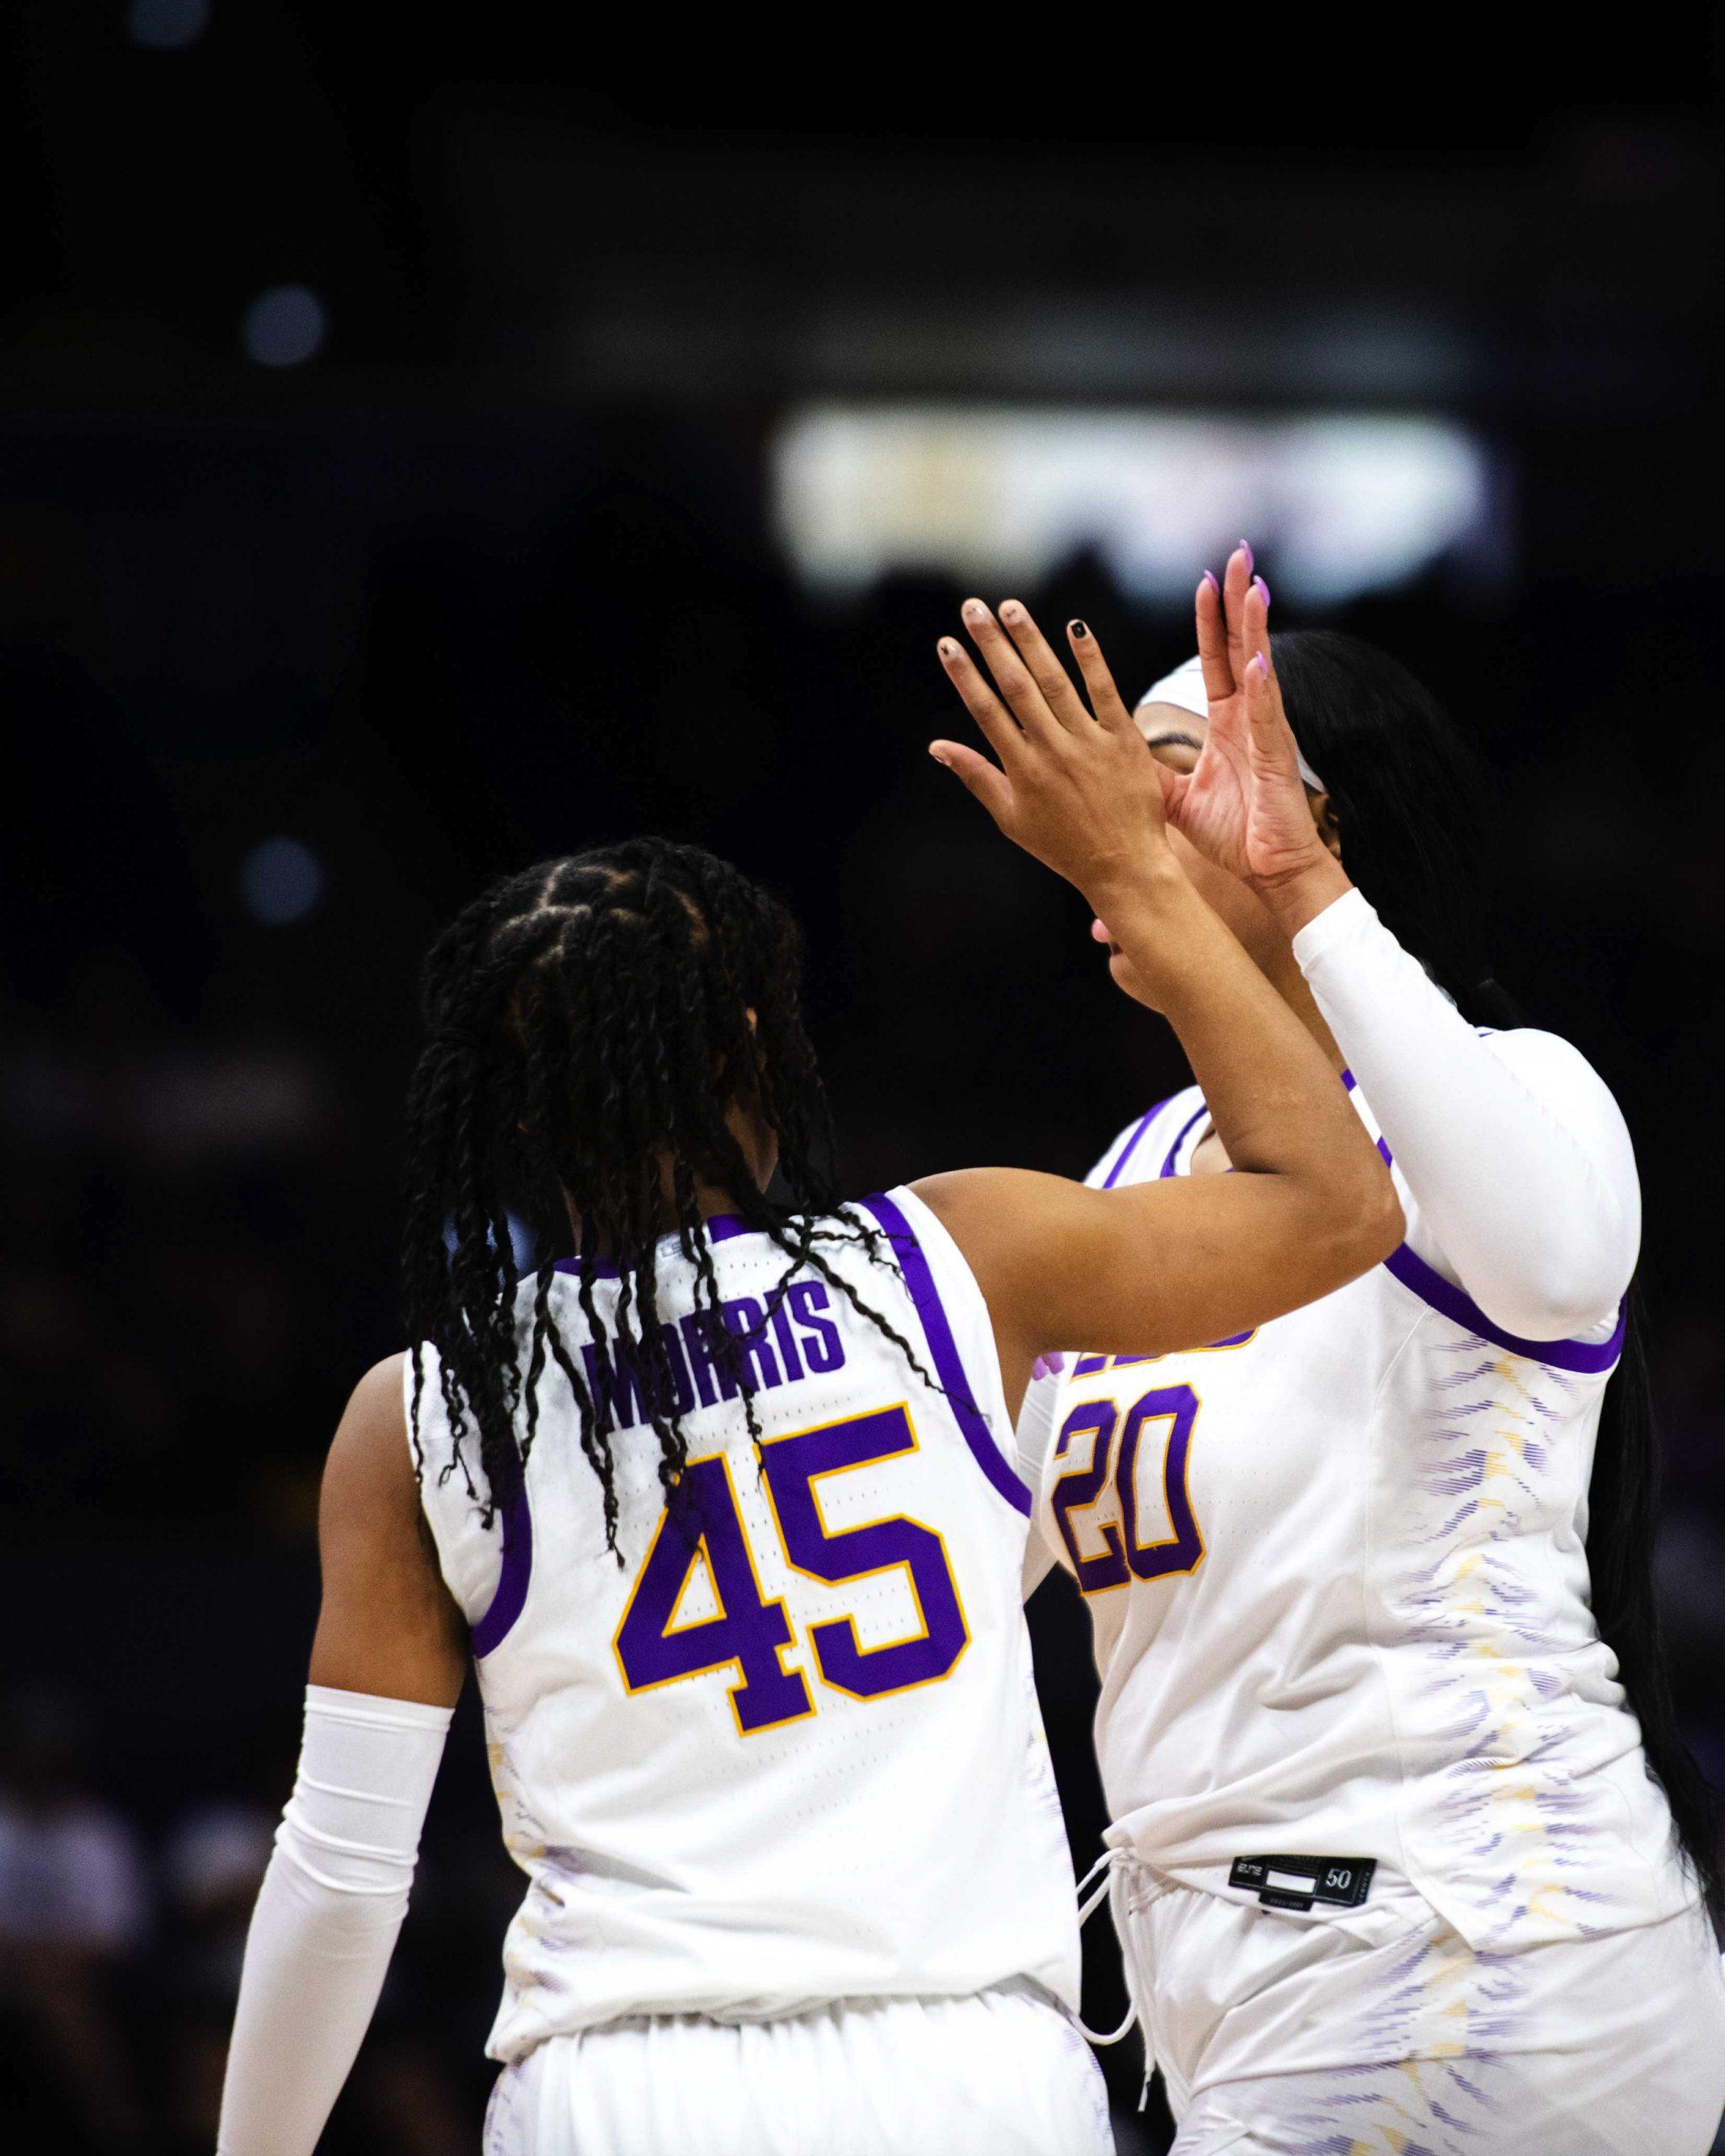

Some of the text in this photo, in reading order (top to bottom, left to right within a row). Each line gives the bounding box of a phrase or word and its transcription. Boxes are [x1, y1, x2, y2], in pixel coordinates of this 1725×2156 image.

[611, 1401, 972, 1737] 45
[1051, 1381, 1206, 1596] 20
[1326, 1868, 1352, 1889] 50
